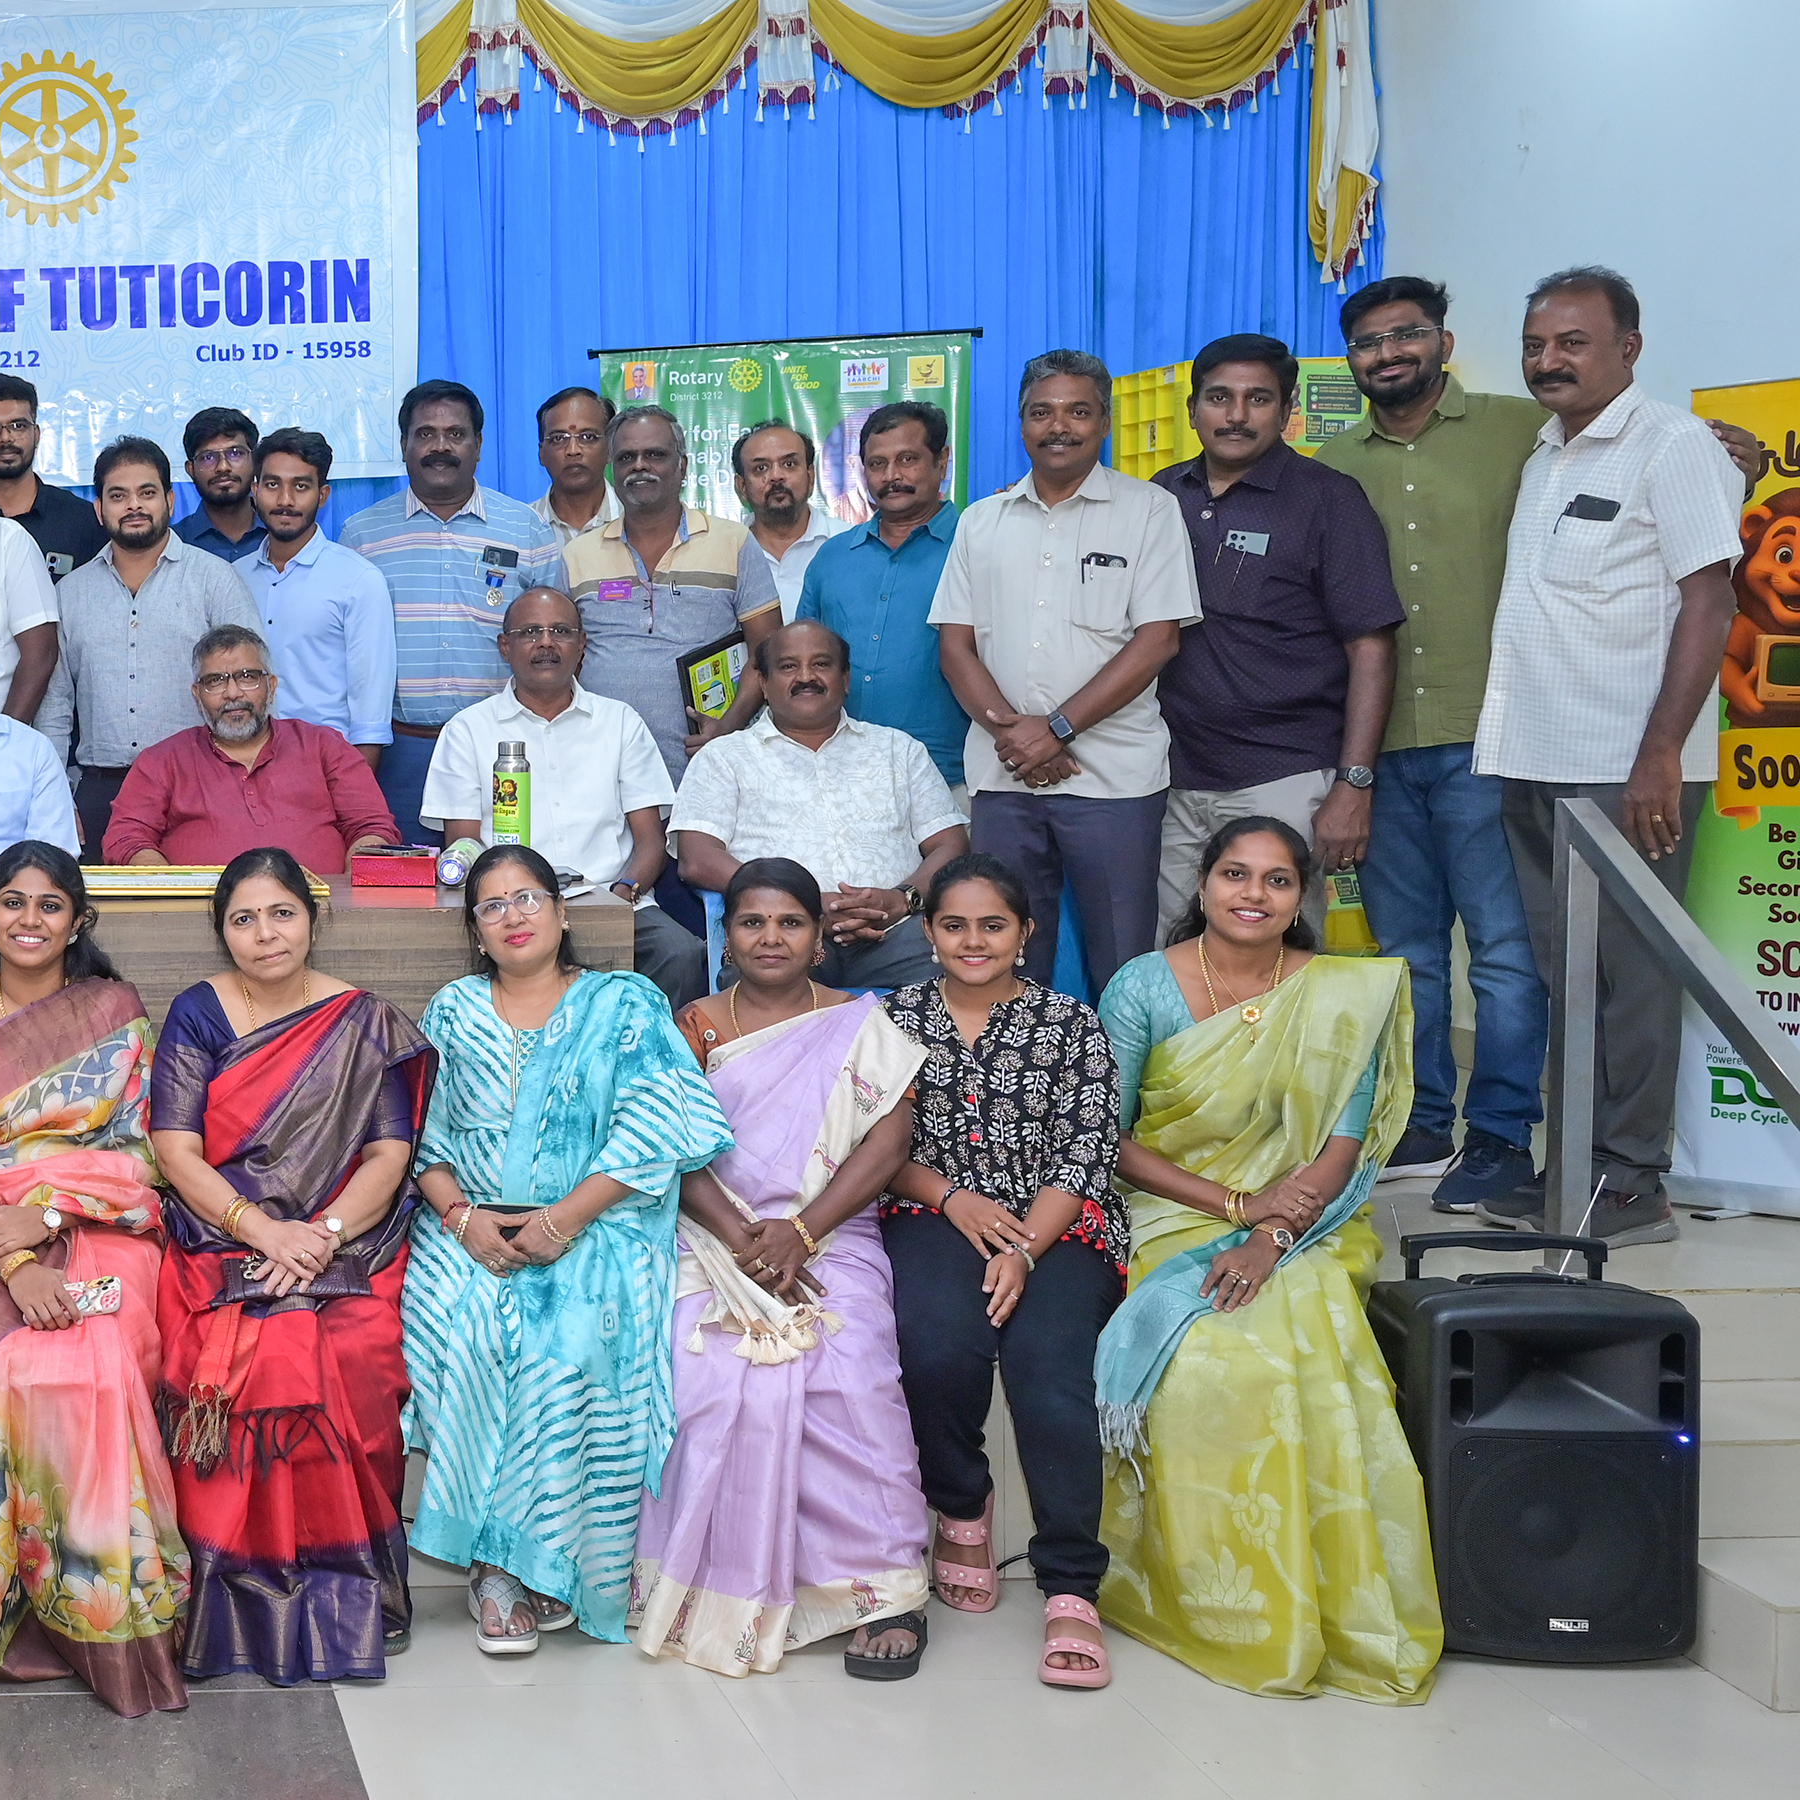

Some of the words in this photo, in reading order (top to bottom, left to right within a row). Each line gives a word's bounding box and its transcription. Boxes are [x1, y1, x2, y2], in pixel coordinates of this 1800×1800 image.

[39, 257, 371, 332] TUTICORIN
[196, 342, 244, 363] Club
[252, 342, 279, 361] ID
[303, 340, 372, 360] 15958
[669, 370, 724, 386] Rotary
[780, 365, 808, 375] UNITE
[790, 373, 810, 382] FOR
[792, 381, 821, 390] GOOD
[669, 391, 700, 402] District
[701, 391, 724, 401] 3212
[692, 424, 722, 442] for
[1768, 823, 1797, 843] Be
[1767, 902, 1800, 924] So
[1755, 990, 1783, 1011] TO
[1706, 1043, 1729, 1054] Your
[1711, 1106, 1747, 1124] Deep
[1750, 1109, 1789, 1126] Cycle
